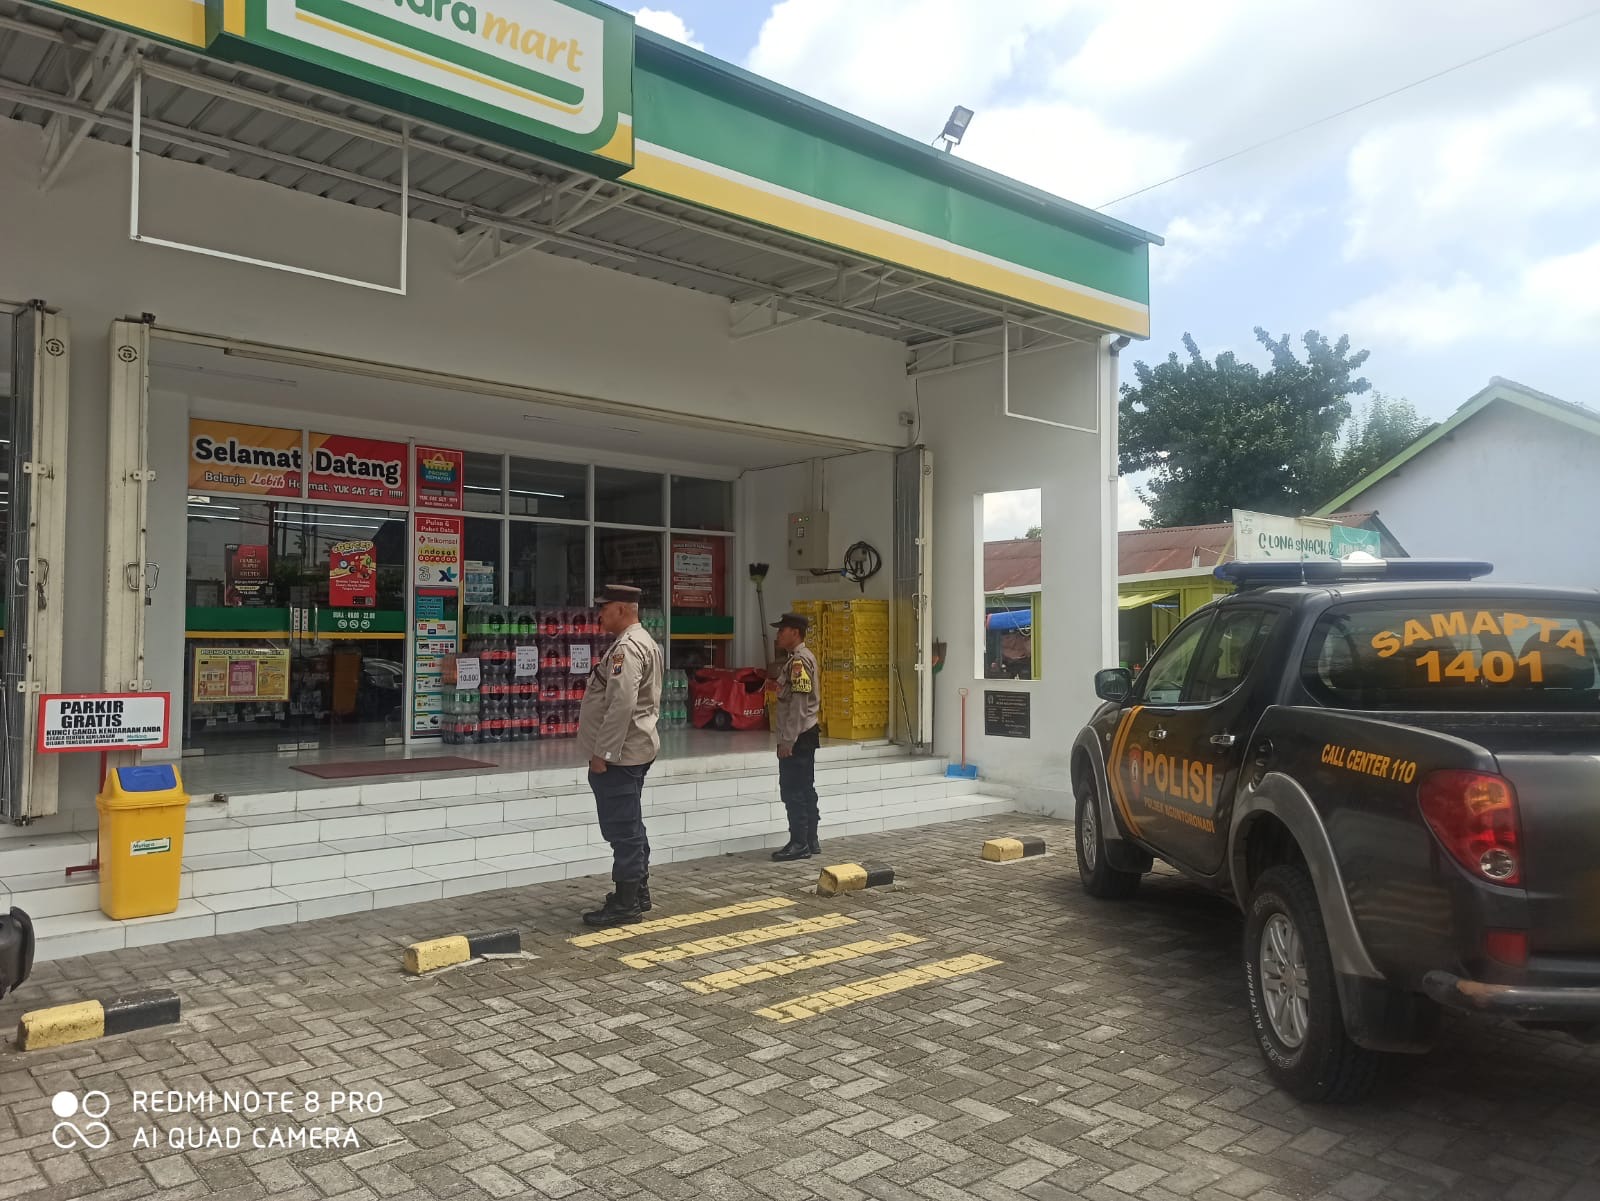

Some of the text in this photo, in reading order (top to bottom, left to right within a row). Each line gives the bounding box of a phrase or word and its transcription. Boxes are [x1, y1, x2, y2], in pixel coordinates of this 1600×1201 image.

[392, 0, 584, 72] ara mart
[196, 438, 400, 485] Selamat Datang
[205, 471, 246, 485] Belanja
[251, 474, 285, 488] Lebih
[333, 484, 350, 496] YUK
[352, 485, 366, 496] SAT
[369, 488, 384, 497] SET
[425, 519, 443, 527] Pulsa
[420, 547, 456, 556] indosat
[427, 536, 458, 545] Telkomsel
[1371, 611, 1586, 658] SAMAPTA
[1415, 650, 1544, 683] 1401
[60, 700, 124, 714] PARKIR
[61, 714, 122, 728] GRATIS
[98, 727, 141, 735] KENDARAAN
[1321, 743, 1417, 784] CALL CENTER 110
[1143, 750, 1214, 808] POLISI
